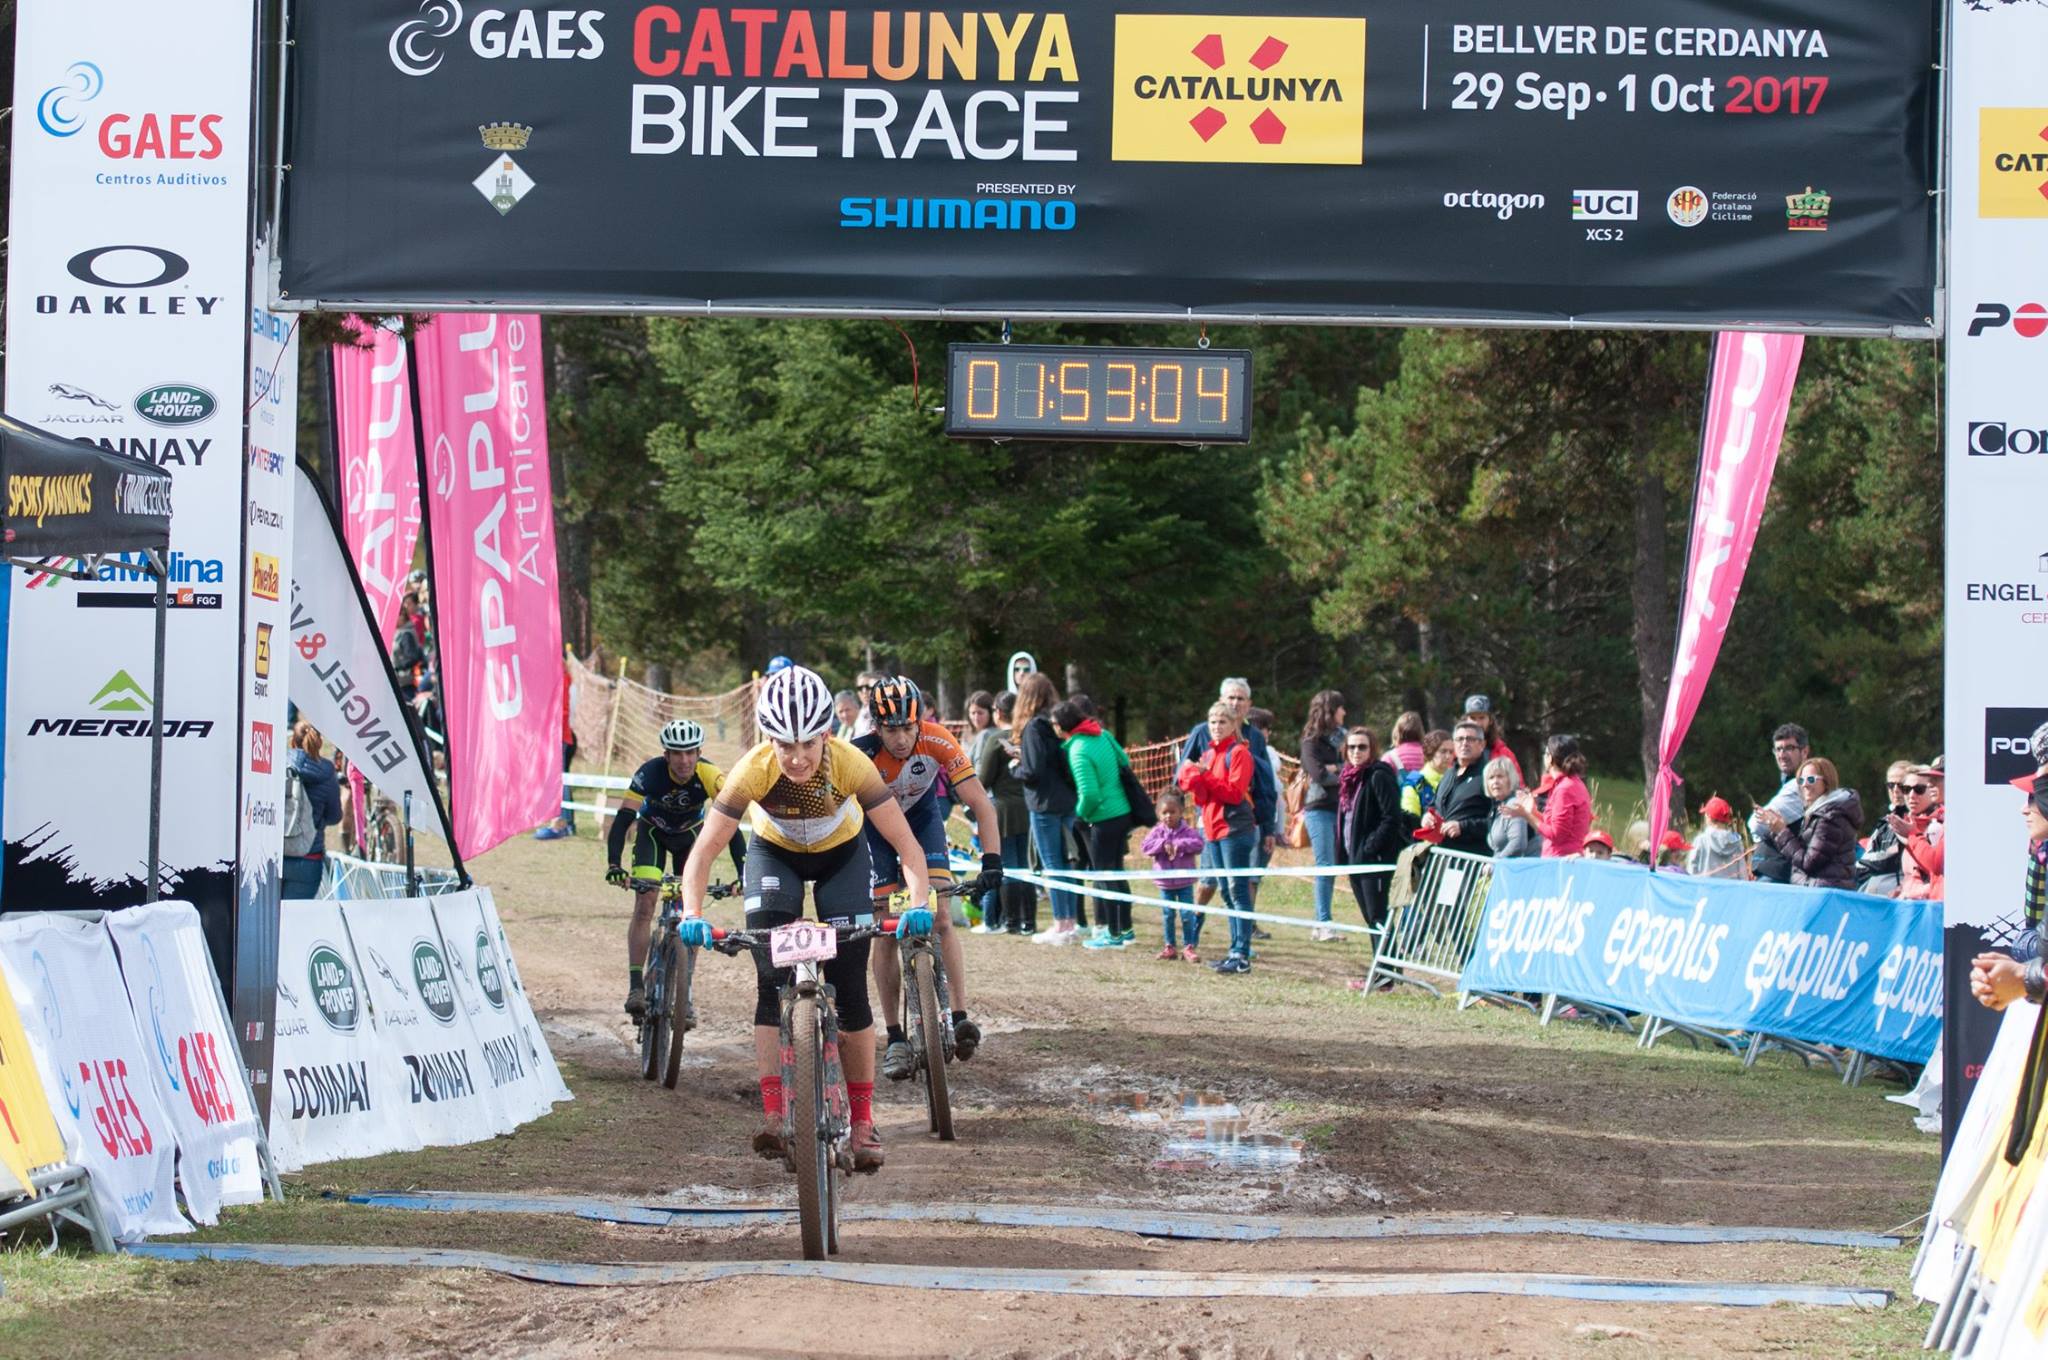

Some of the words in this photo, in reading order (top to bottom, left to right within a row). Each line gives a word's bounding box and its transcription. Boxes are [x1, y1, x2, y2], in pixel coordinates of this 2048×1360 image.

[469, 9, 605, 59] GAES
[633, 5, 1079, 82] CATALUNYA
[1453, 25, 1596, 55] BELLVER
[1605, 27, 1647, 55] DE
[1655, 28, 1828, 58] CERDANYA
[1134, 75, 1343, 102] CATALUNYA
[1451, 72, 1504, 110] 29
[1618, 74, 1636, 112] 1
[1651, 74, 1715, 112] Oct
[1724, 76, 1829, 114] 2017
[630, 84, 820, 157] BIKE
[842, 88, 1079, 161] RACE
[98, 113, 223, 160] GAES
[1995, 153, 2048, 172] CAT
[96, 173, 151, 185] Centros
[157, 172, 227, 186] Auditivos
[976, 183, 1054, 195] PRESENTED
[1057, 184, 1076, 195] BY
[1443, 190, 1545, 220] octagon
[1584, 195, 1633, 215] UCI
[1712, 192, 1757, 201] Federació
[1712, 202, 1752, 211] Catalana
[840, 197, 1076, 230] SHIMANO
[1712, 213, 1753, 221] Ciclisme
[1586, 229, 1612, 241] XCS
[1615, 229, 1623, 240] 2
[36, 295, 218, 315] OAKLEY
[150, 391, 188, 404] LAND
[38, 414, 124, 424] JAGUAR
[152, 405, 203, 417] ROVER
[506, 319, 545, 586] Arthicare
[196, 596, 217, 605] FGC
[1967, 583, 2044, 601] ENGEL
[27, 719, 214, 738] MERIDA
[1991, 737, 2030, 755] PO
[1487, 875, 1595, 974] epaplus
[1603, 897, 1730, 994] epaplus
[1745, 911, 1870, 1016] epaplus
[314, 962, 340, 987] LAND
[284, 1060, 371, 1119] DONNAY
